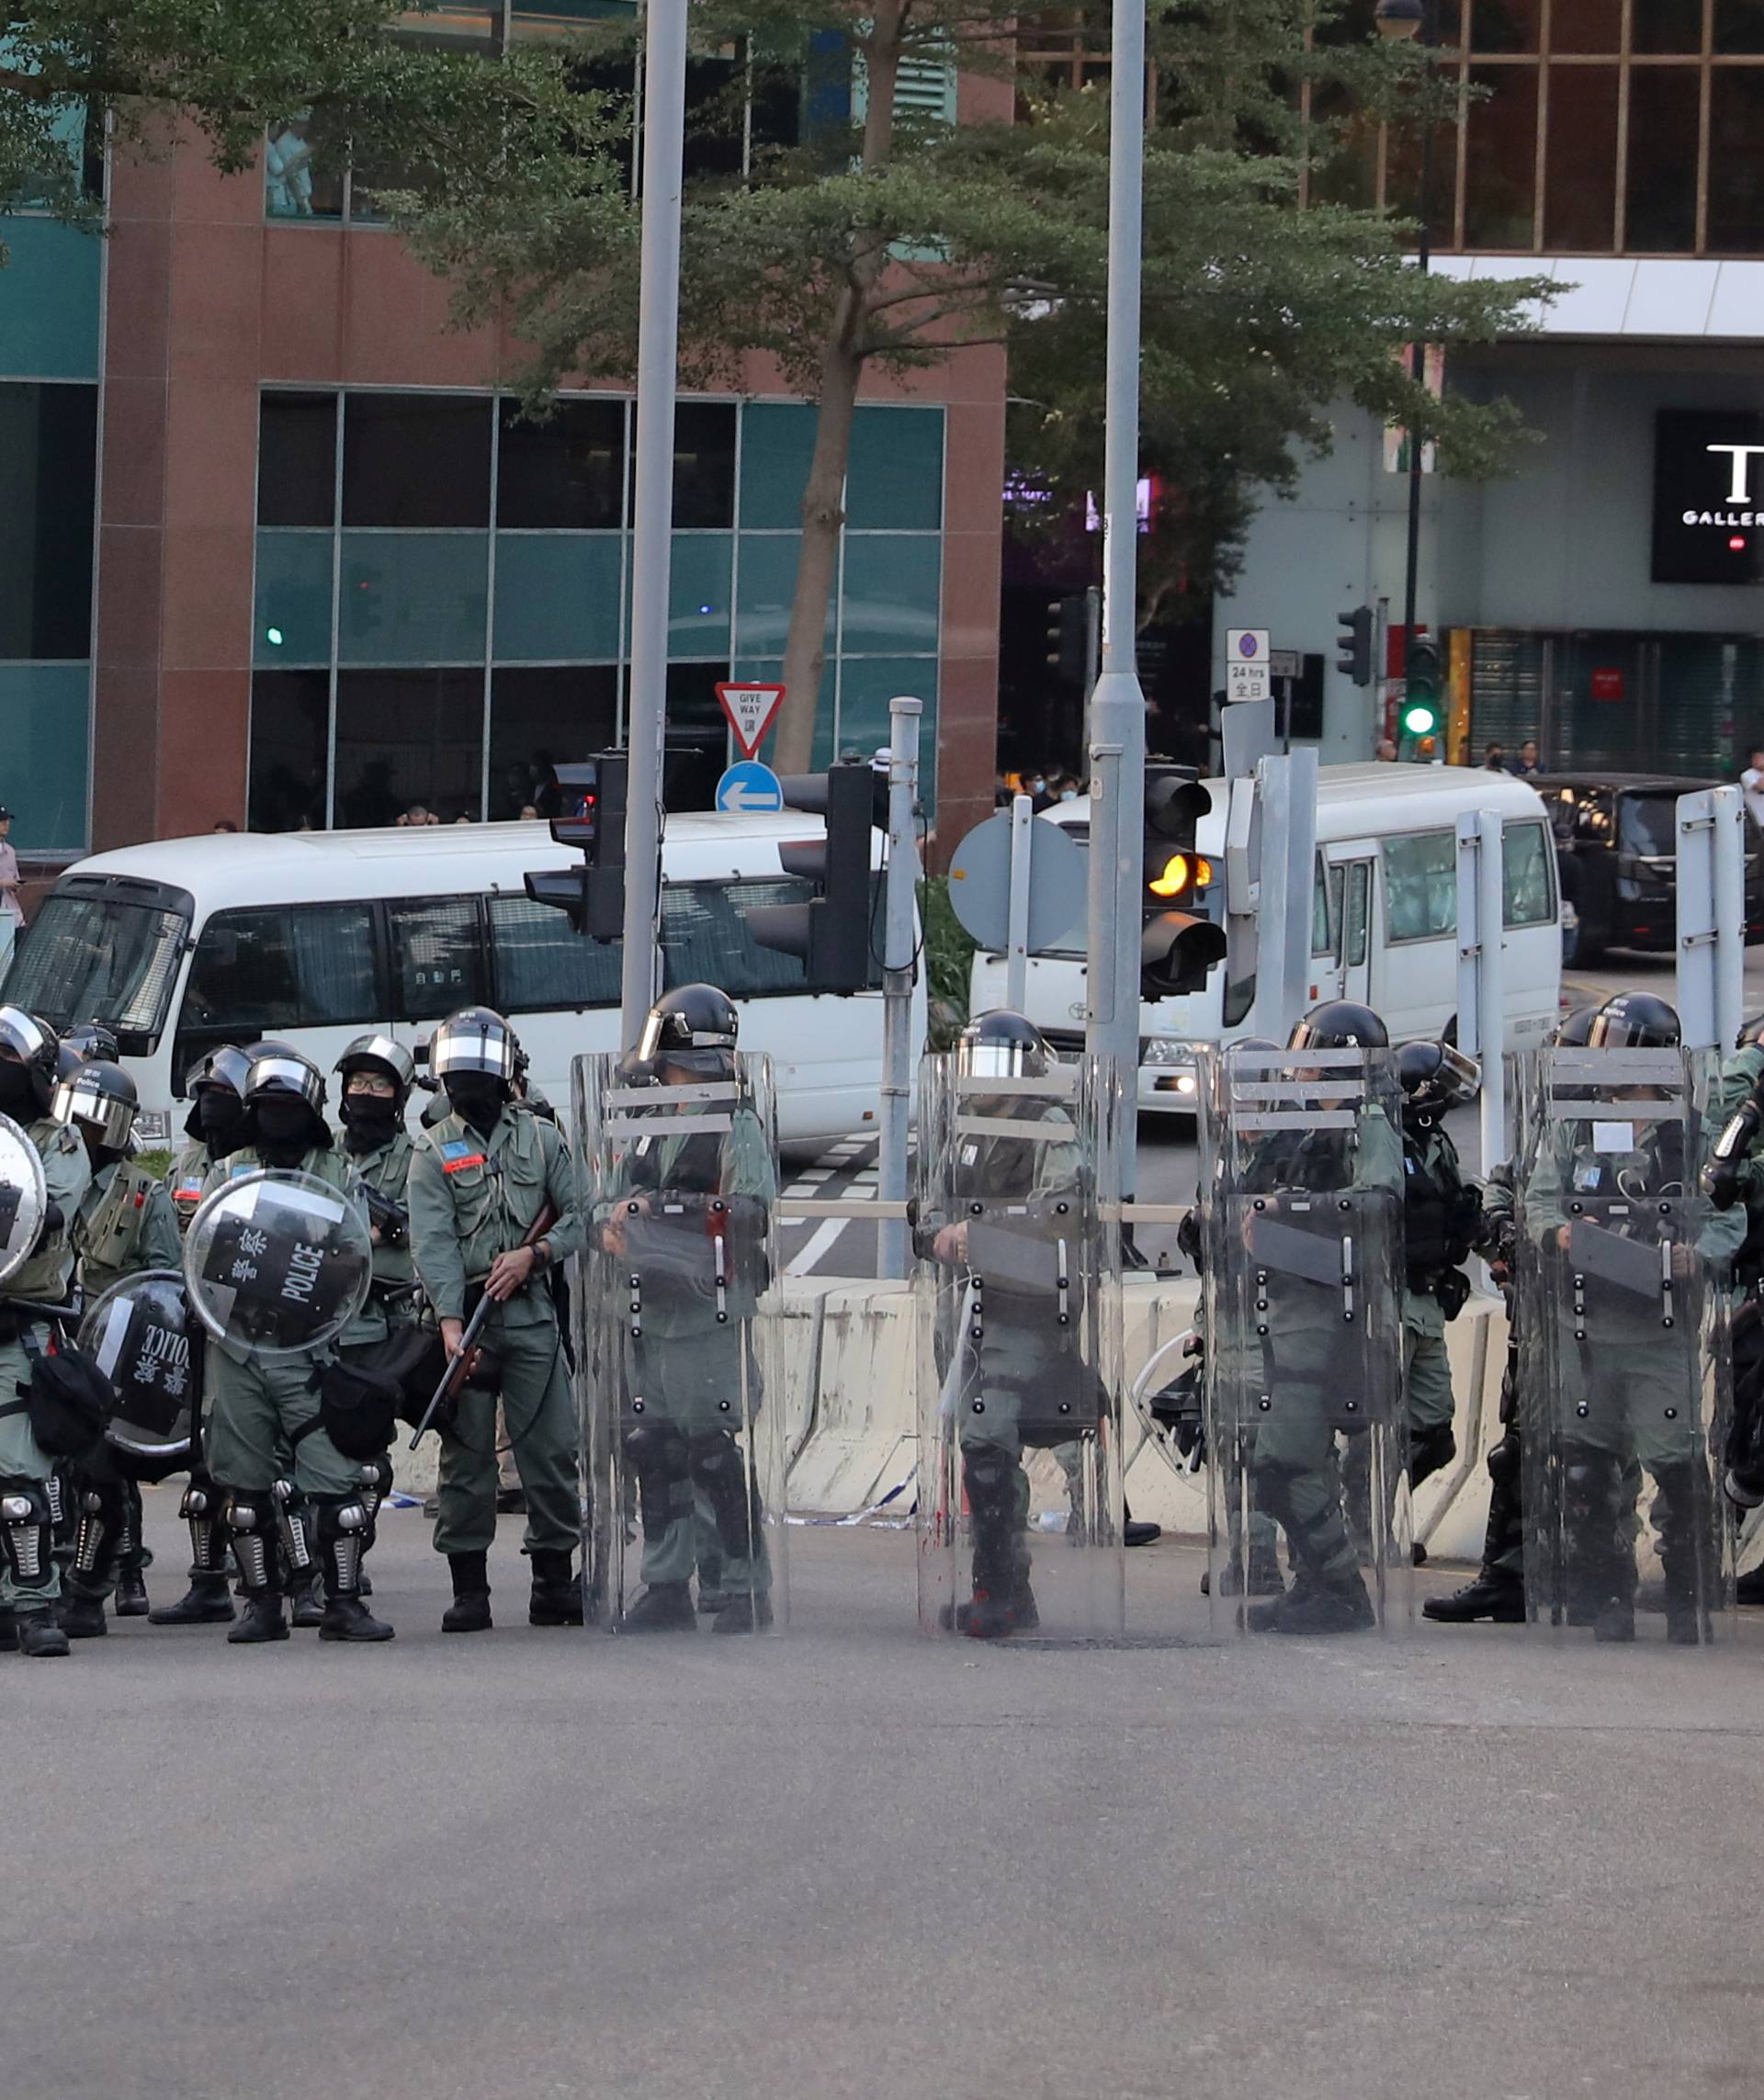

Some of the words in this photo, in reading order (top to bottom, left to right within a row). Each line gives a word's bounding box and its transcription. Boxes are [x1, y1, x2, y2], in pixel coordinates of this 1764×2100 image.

[1706, 445, 1764, 503] T
[1232, 667, 1246, 678] 24
[1249, 666, 1264, 678] hrs
[1236, 683, 1261, 697] 全日
[740, 694, 762, 703] GIVE
[740, 706, 761, 714] WAY
[76, 1077, 100, 1088] Police
[232, 1227, 267, 1282] 警察
[281, 1242, 324, 1304] POLICE
[133, 1356, 188, 1396] 警察
